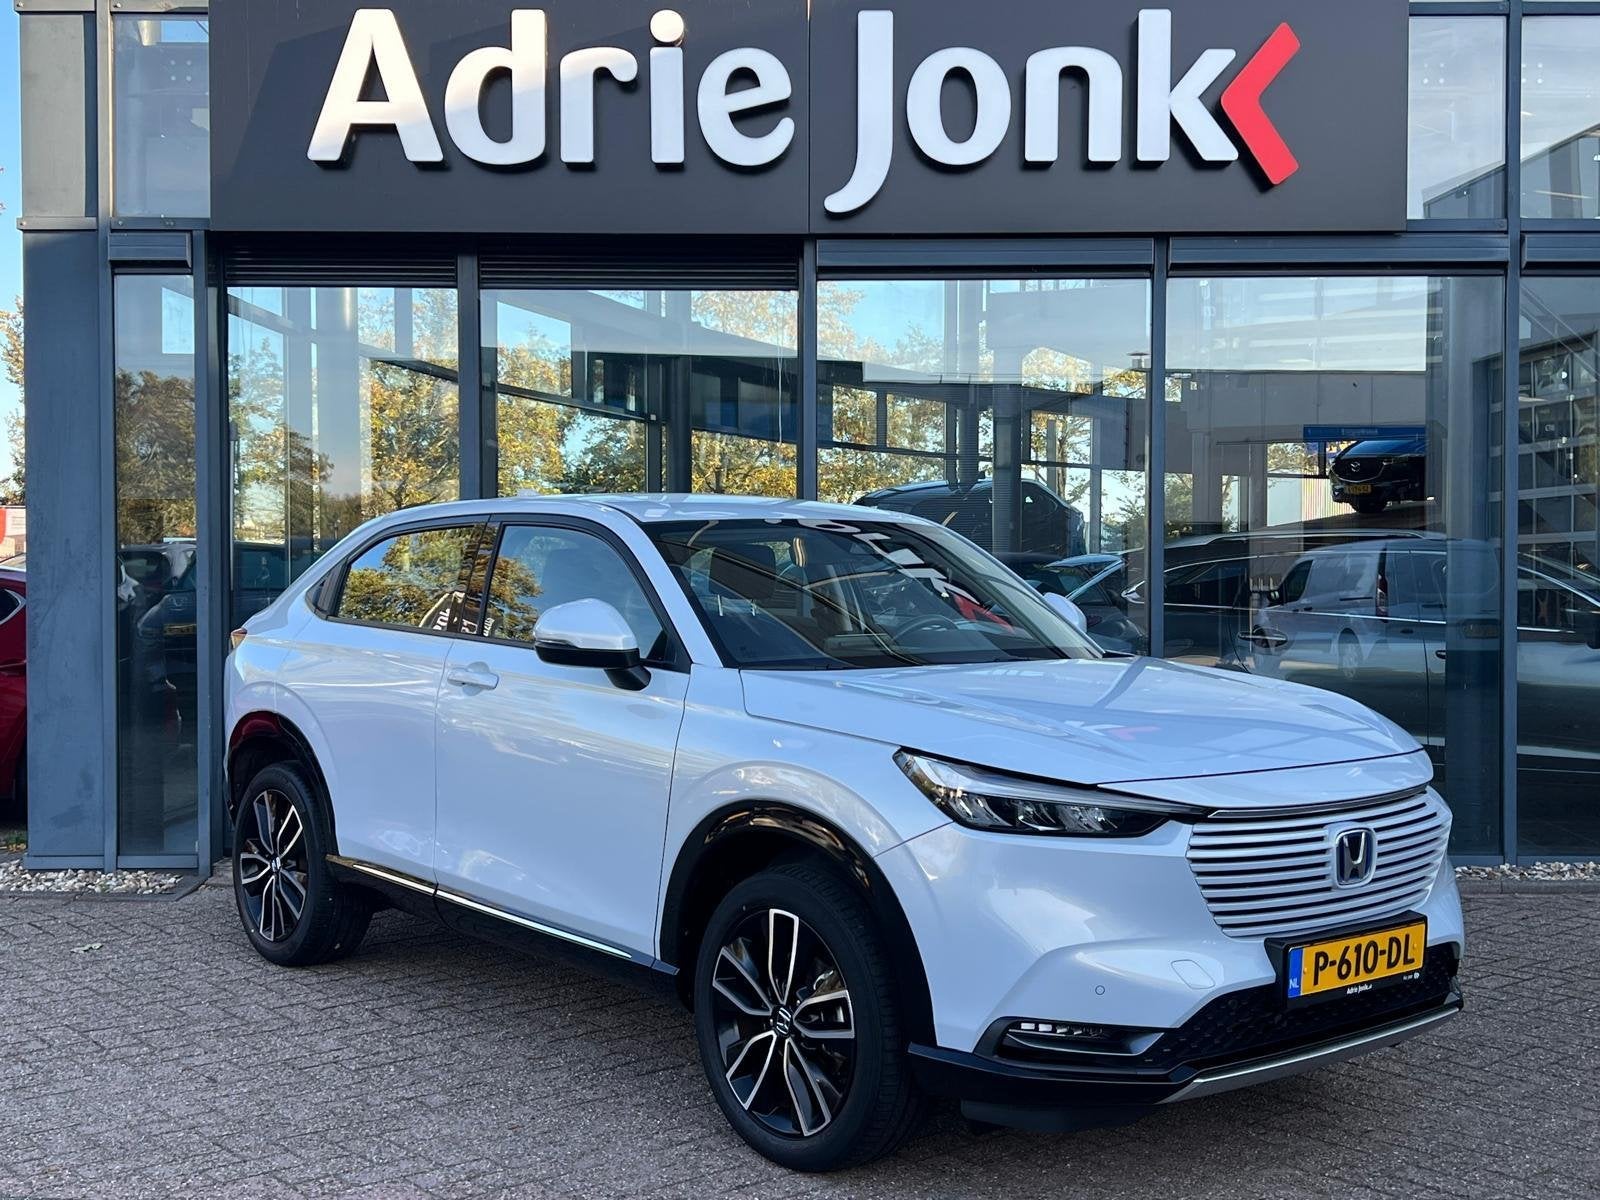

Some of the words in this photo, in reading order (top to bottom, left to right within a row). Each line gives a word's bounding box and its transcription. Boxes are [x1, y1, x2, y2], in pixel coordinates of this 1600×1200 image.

[307, 8, 795, 167] Adrie
[824, 9, 1239, 213] Jonk
[1289, 979, 1299, 990] NL
[1313, 933, 1415, 987] P-610-DL
